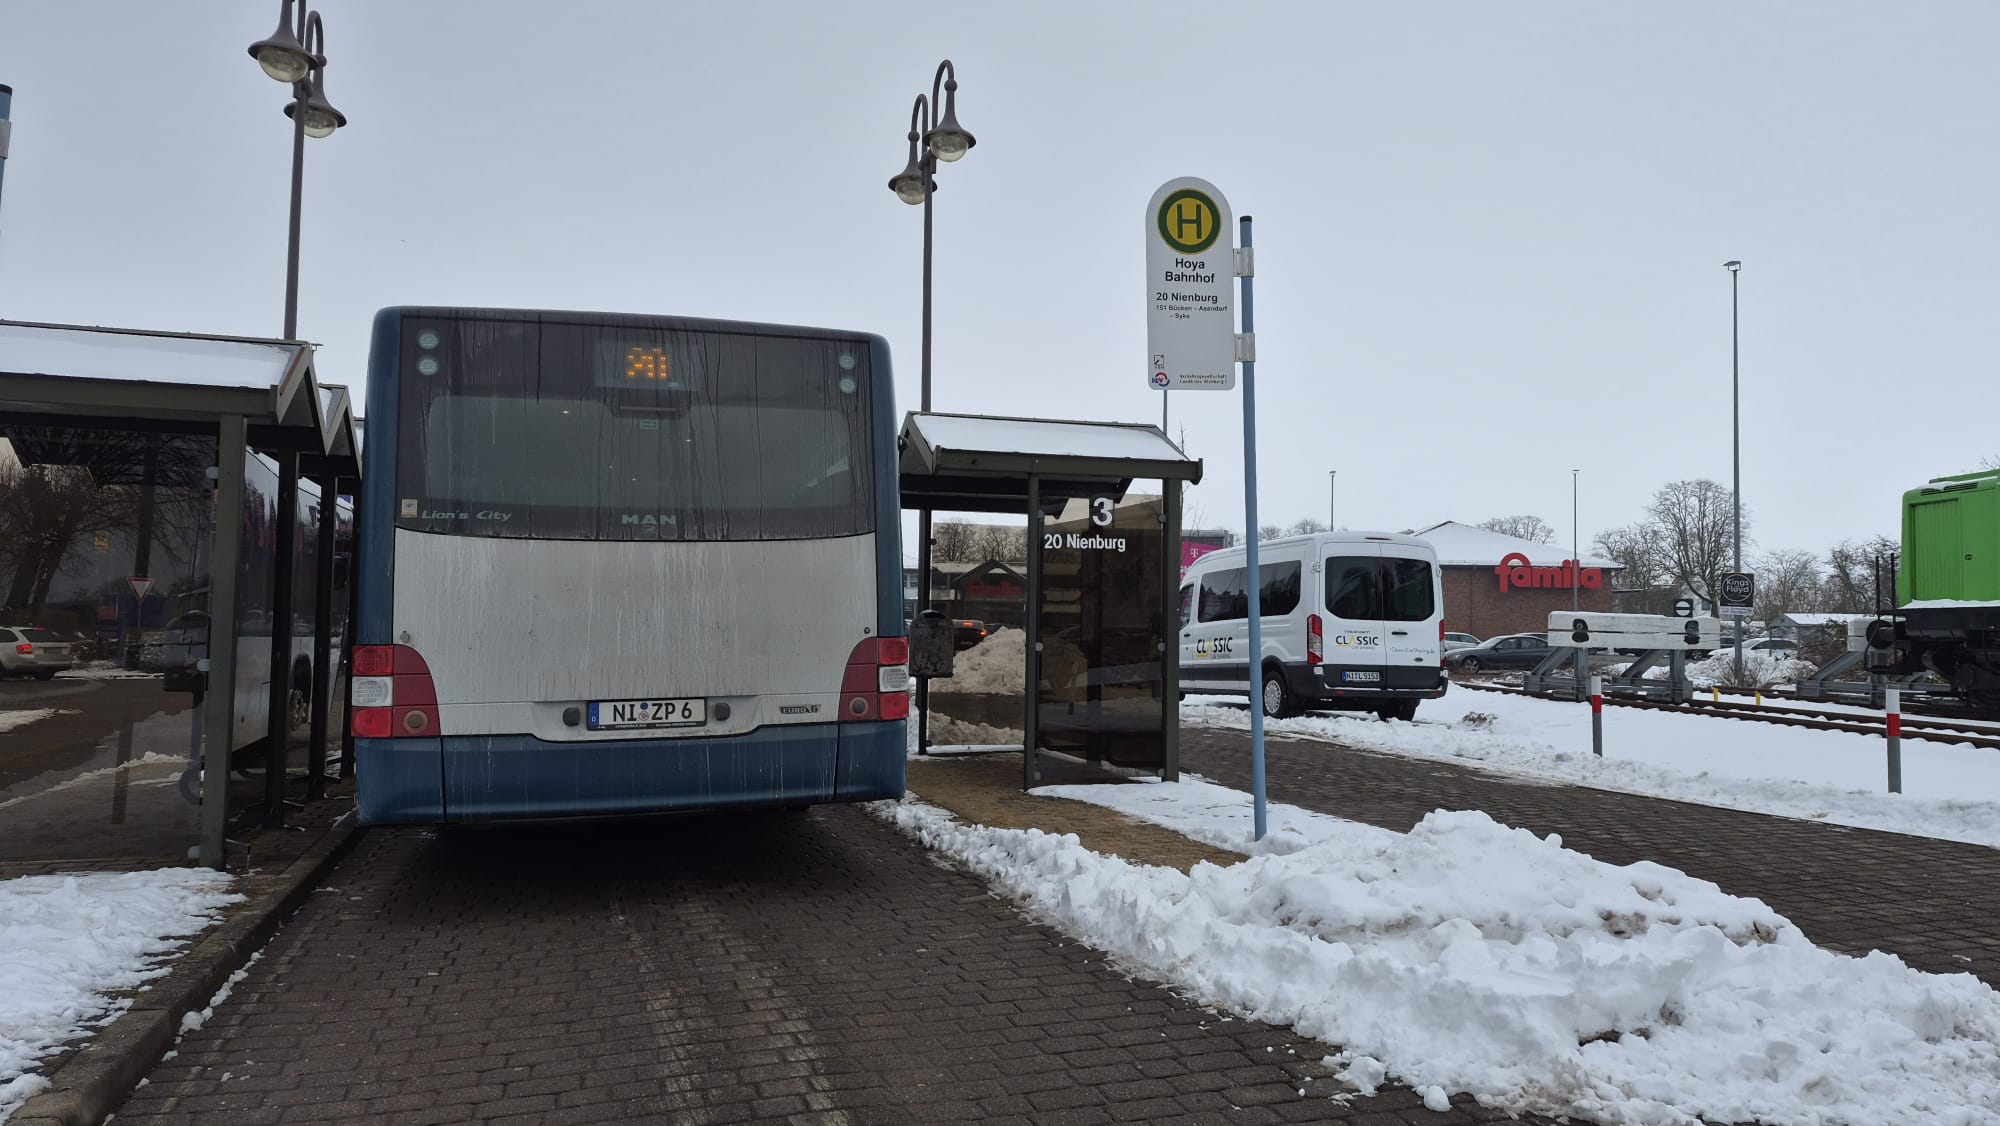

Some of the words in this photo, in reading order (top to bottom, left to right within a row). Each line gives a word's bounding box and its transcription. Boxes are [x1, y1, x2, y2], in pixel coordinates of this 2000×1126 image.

[1177, 204, 1202, 239] H
[1175, 258, 1205, 271] Hoya
[1165, 271, 1215, 283] Bahnhof
[1156, 292, 1168, 301] 20
[1171, 292, 1218, 304] Nienburg
[421, 509, 469, 519] Lion's
[476, 510, 512, 521] City
[1092, 497, 1114, 526] 3
[622, 514, 677, 525] MAN
[1044, 533, 1063, 549] 20
[1066, 533, 1126, 552] Nienburg
[1494, 552, 1602, 593] famila
[1726, 579, 1749, 587] Kings
[1726, 586, 1749, 594] Floyd
[1196, 637, 1232, 654] CLASSIC
[1335, 635, 1379, 646] CLASSIC
[613, 704, 638, 722] NI
[651, 702, 676, 720] ZP
[681, 701, 692, 719] 6
